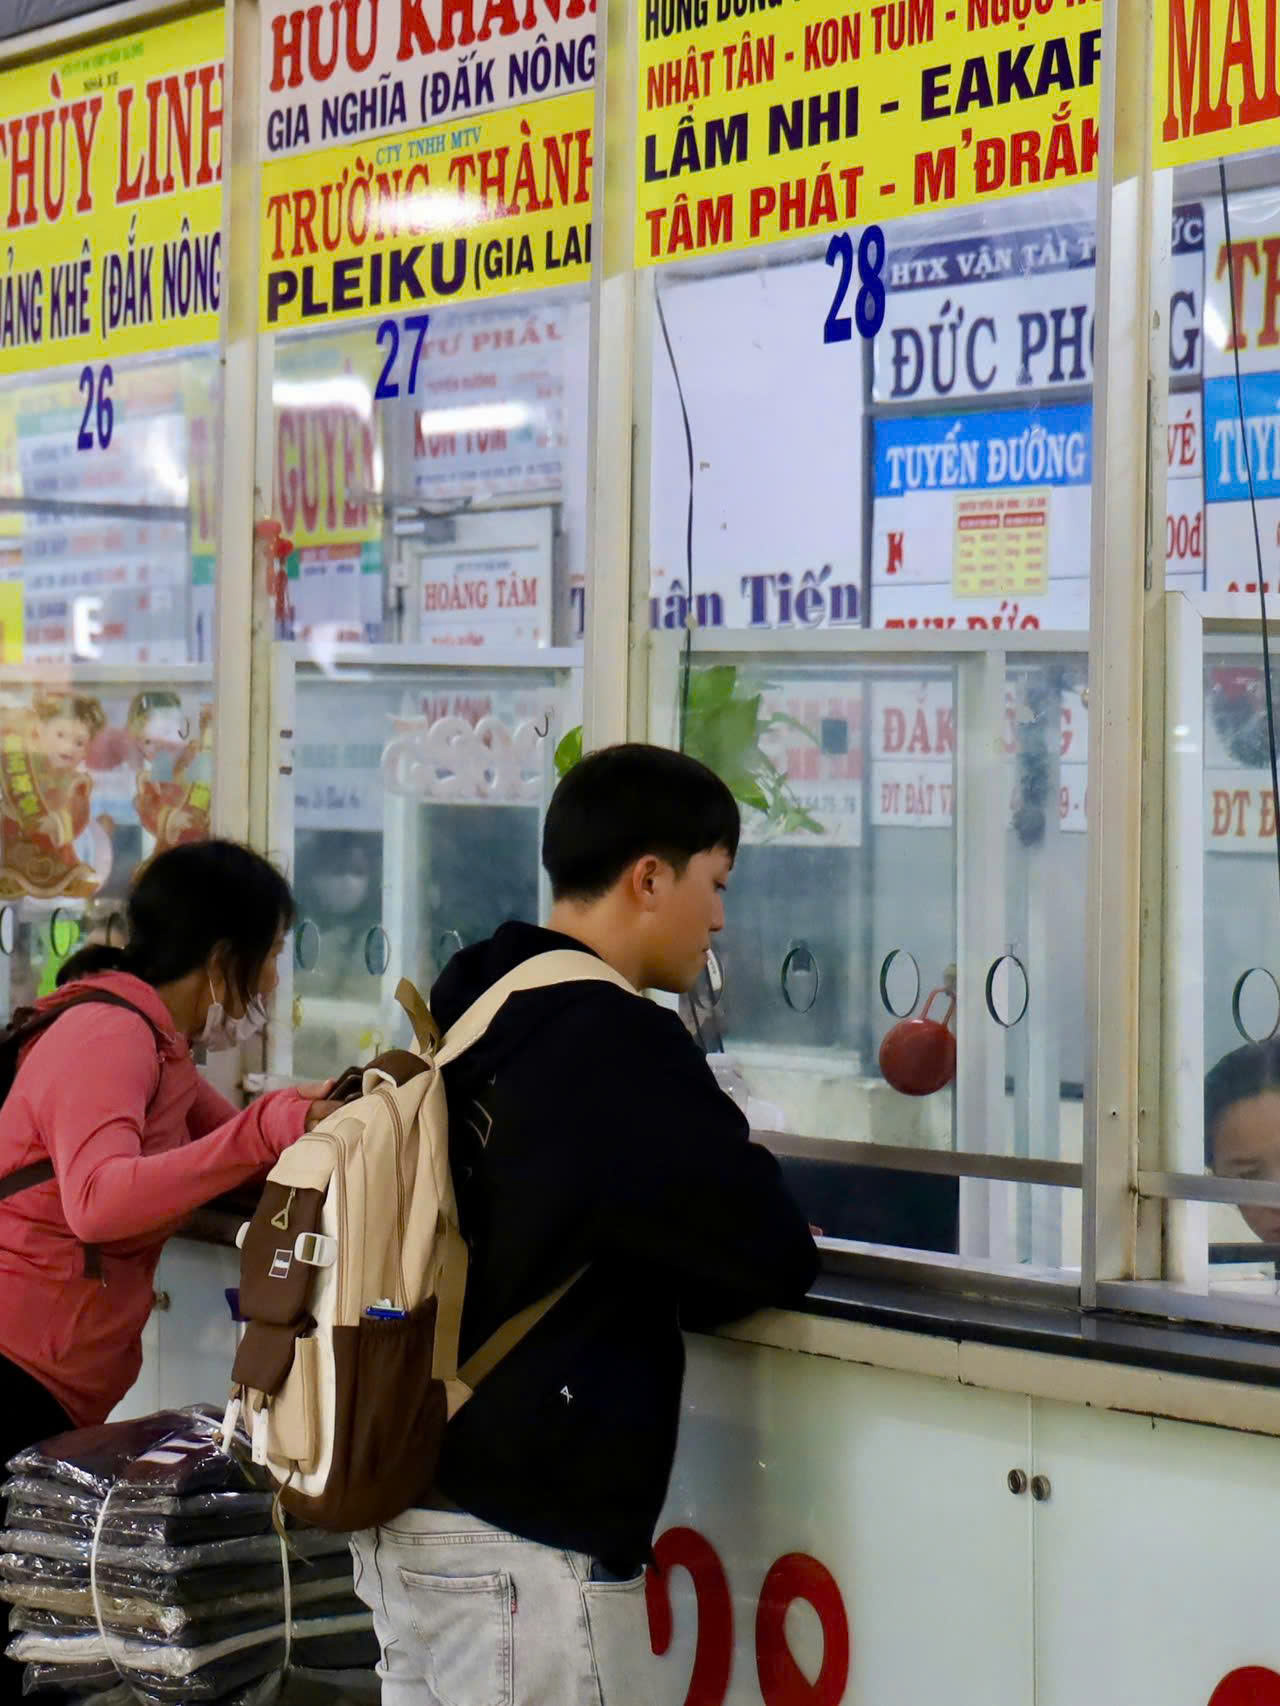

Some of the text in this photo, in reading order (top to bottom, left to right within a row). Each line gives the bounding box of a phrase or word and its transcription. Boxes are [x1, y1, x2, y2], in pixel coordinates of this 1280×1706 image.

[647, 46, 714, 113] NHẬT
[723, 32, 775, 92] TÂN
[804, 12, 860, 72] KON
[871, 0, 934, 55] TUM
[268, 104, 310, 152] GIA
[321, 73, 407, 141] NGHĨA
[376, 126, 482, 165] CTY TNHH MTV
[645, 114, 749, 183] LÂM
[769, 86, 859, 156] NHI
[646, 192, 734, 257] TÂM
[749, 161, 864, 238] PHÁT
[50, 238, 92, 339] KHÊ
[268, 238, 467, 323] PLEIKU
[474, 234, 534, 290] (GIA
[823, 225, 886, 344] 28
[891, 259, 948, 286] HTX
[957, 246, 1013, 279] VẬN
[374, 315, 429, 400] 27
[890, 299, 998, 399] ĐỨC
[77, 364, 114, 450] 26
[886, 420, 979, 490] TUYẾN
[741, 564, 861, 629] Tiến
